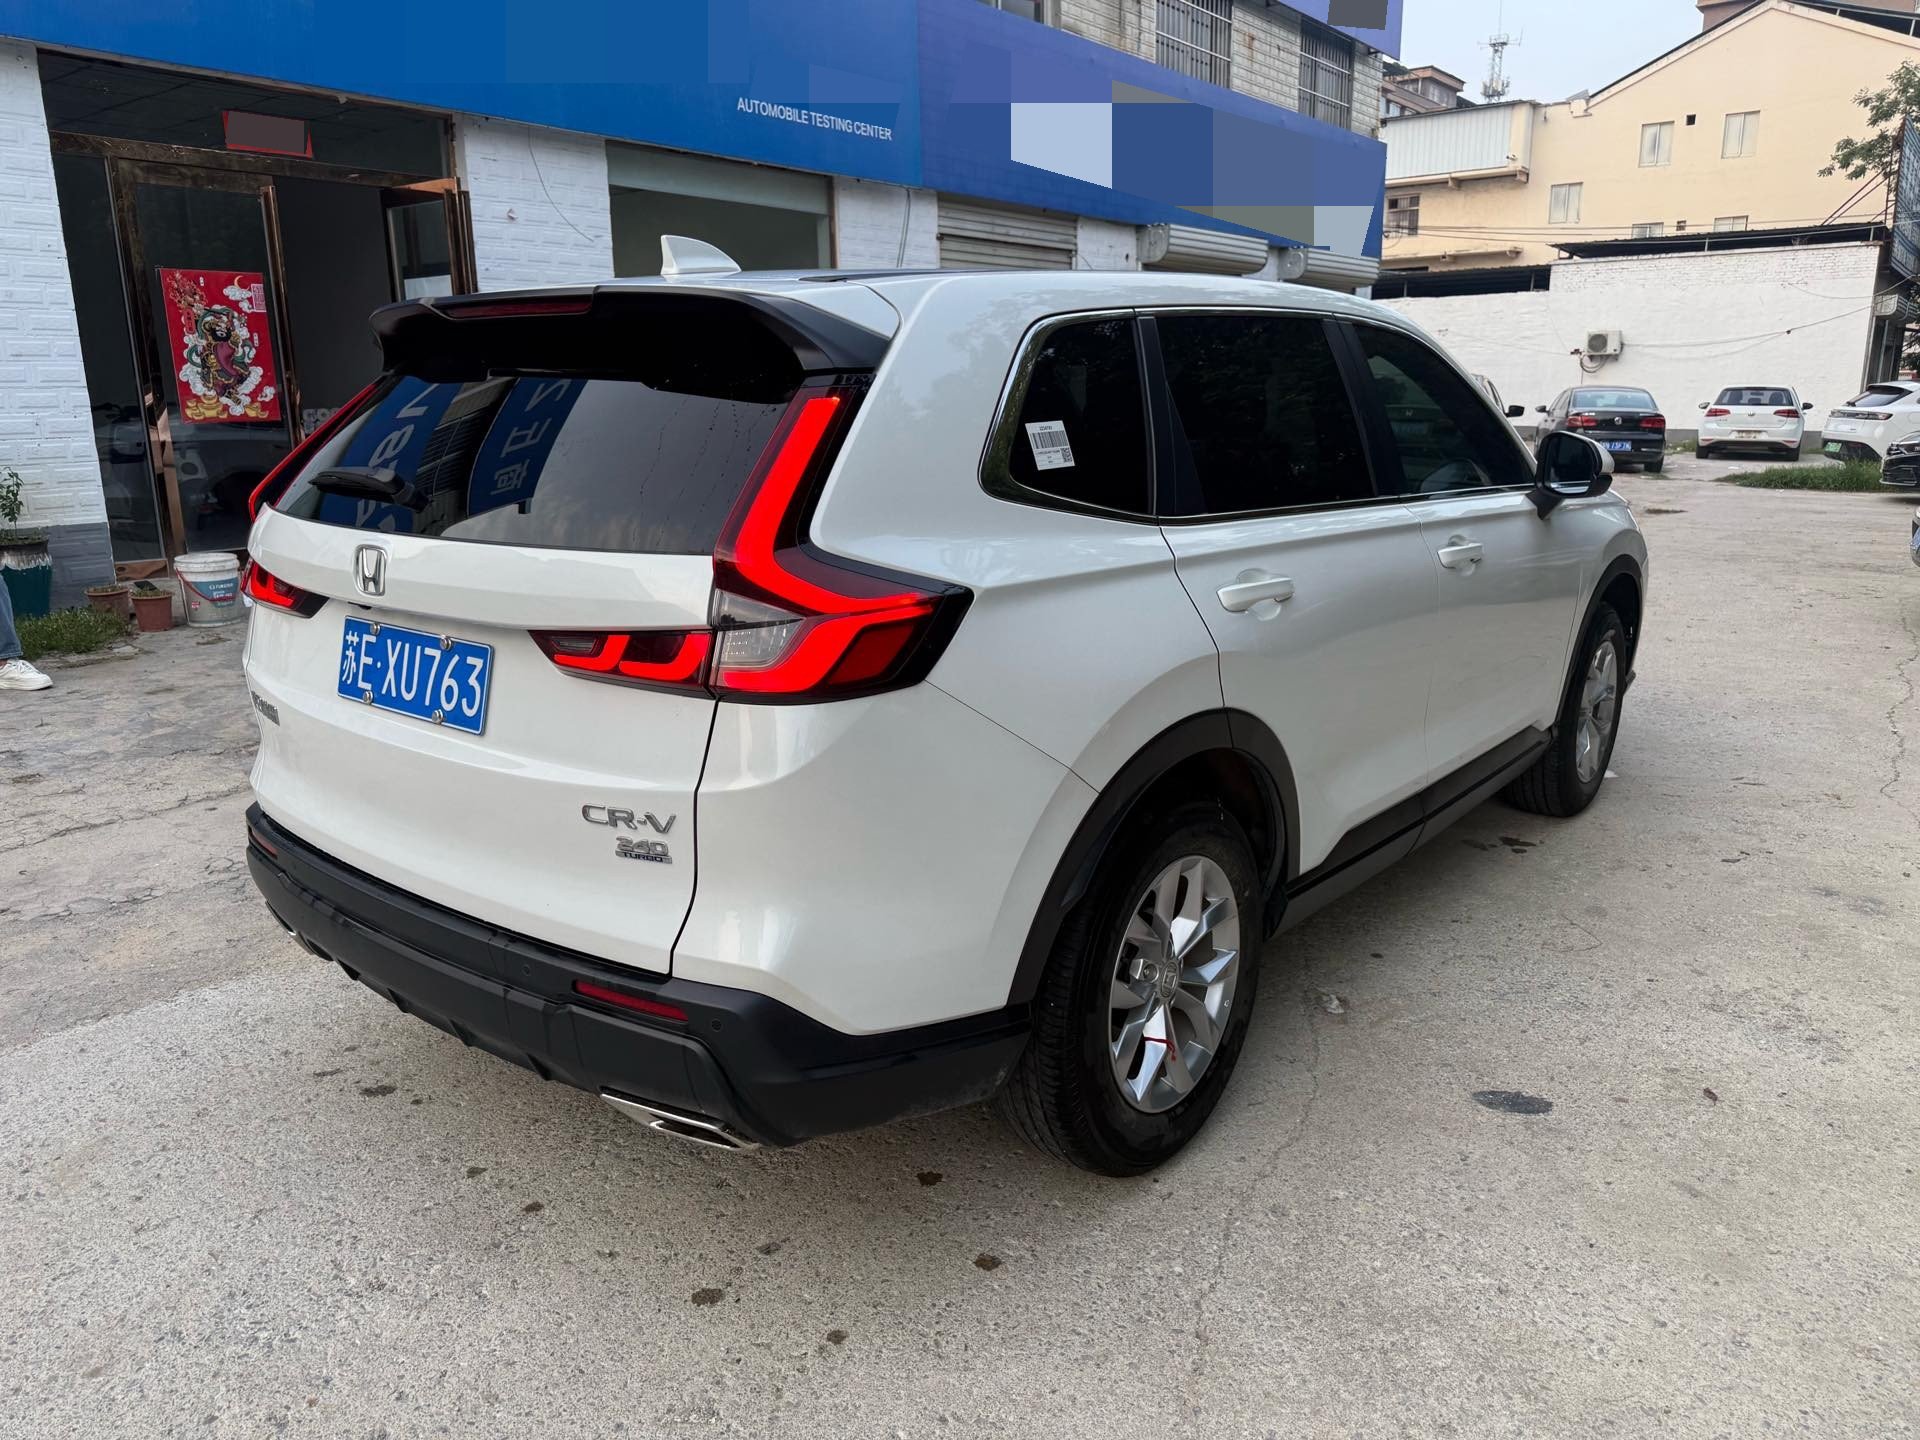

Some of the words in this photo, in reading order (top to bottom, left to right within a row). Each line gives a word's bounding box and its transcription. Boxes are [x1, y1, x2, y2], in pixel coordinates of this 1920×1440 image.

[737, 97, 809, 125] AUTOMOBILE
[810, 111, 853, 133] TESTING
[854, 121, 893, 141] CENTER
[581, 803, 677, 835] CR-V
[615, 835, 669, 857] 240
[623, 851, 664, 863] TURBO
